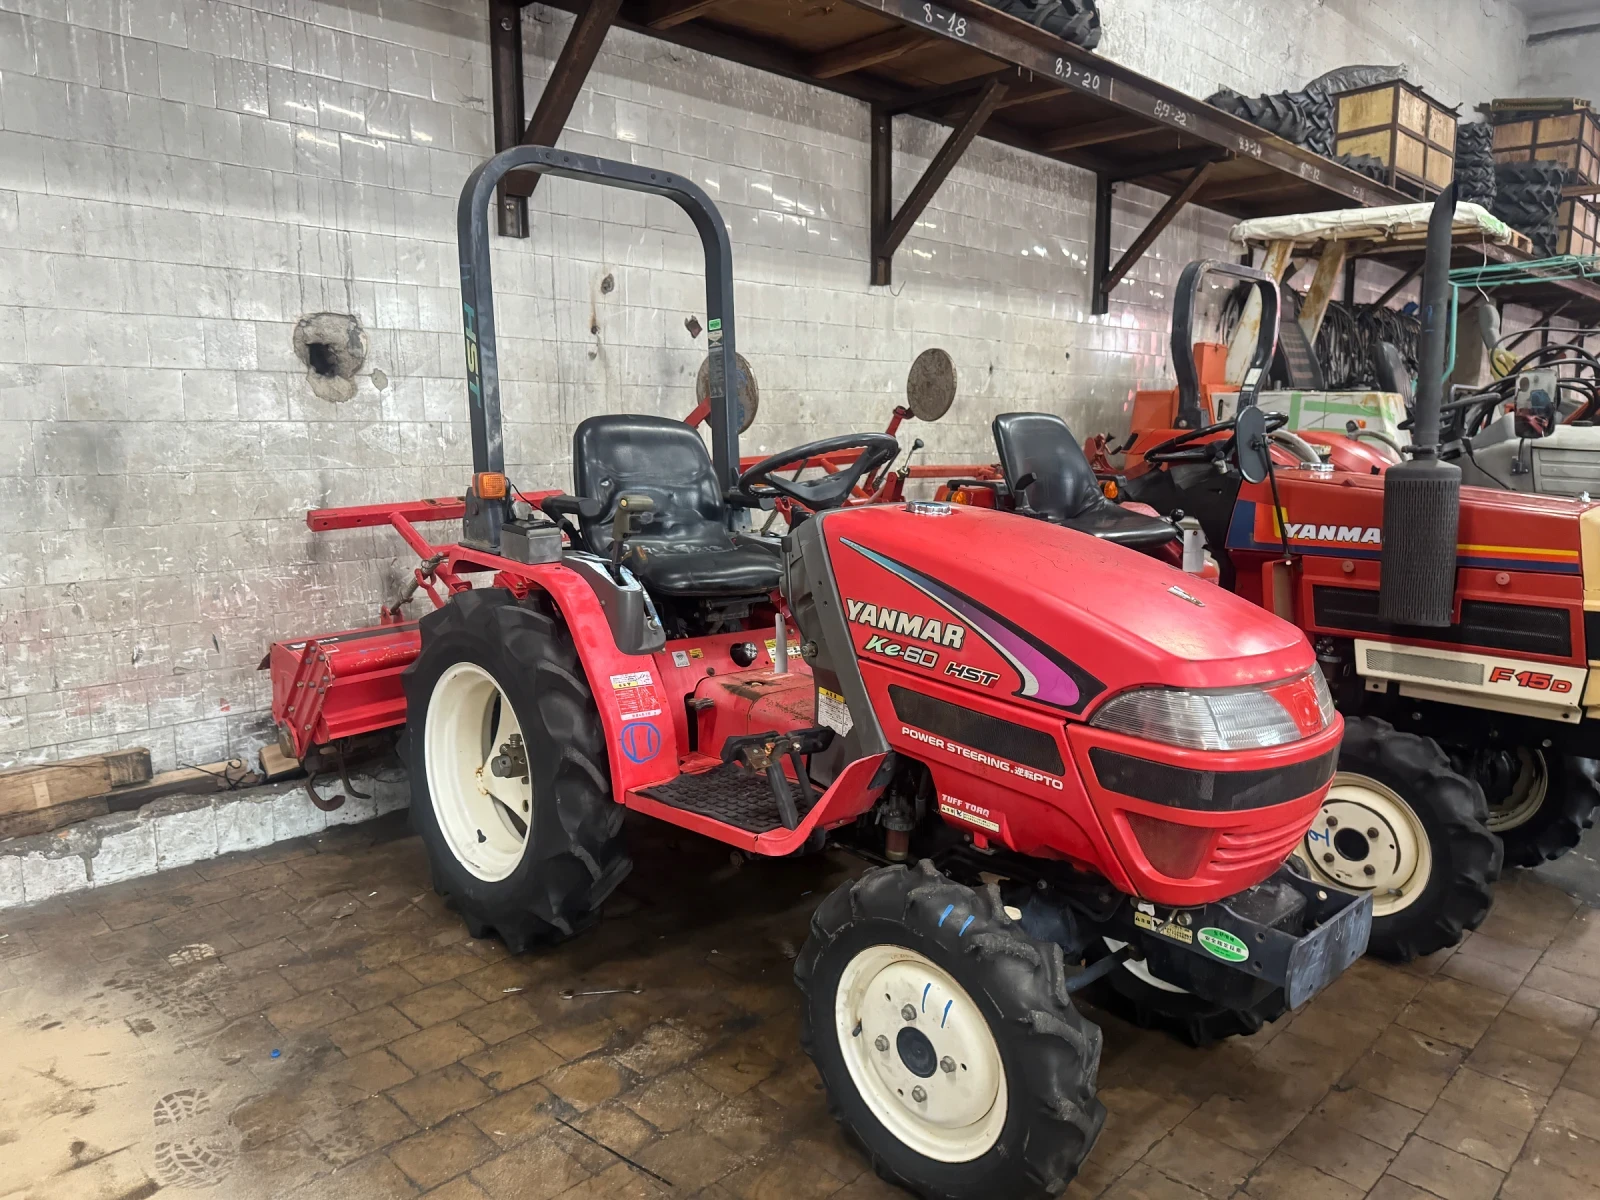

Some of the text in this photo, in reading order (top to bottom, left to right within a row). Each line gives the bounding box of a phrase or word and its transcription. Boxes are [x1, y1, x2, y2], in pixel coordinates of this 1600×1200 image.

[922, 3, 966, 37] 8-18
[464, 302, 482, 408] HST
[1283, 524, 1382, 544] YANMA
[846, 599, 966, 649] YANMAR
[865, 635, 939, 669] Ke-60
[945, 662, 1000, 688] HST
[1489, 667, 1573, 694] F15D
[902, 726, 945, 749] POWER
[941, 793, 963, 808] TUFF
[964, 801, 990, 818] TORQ
